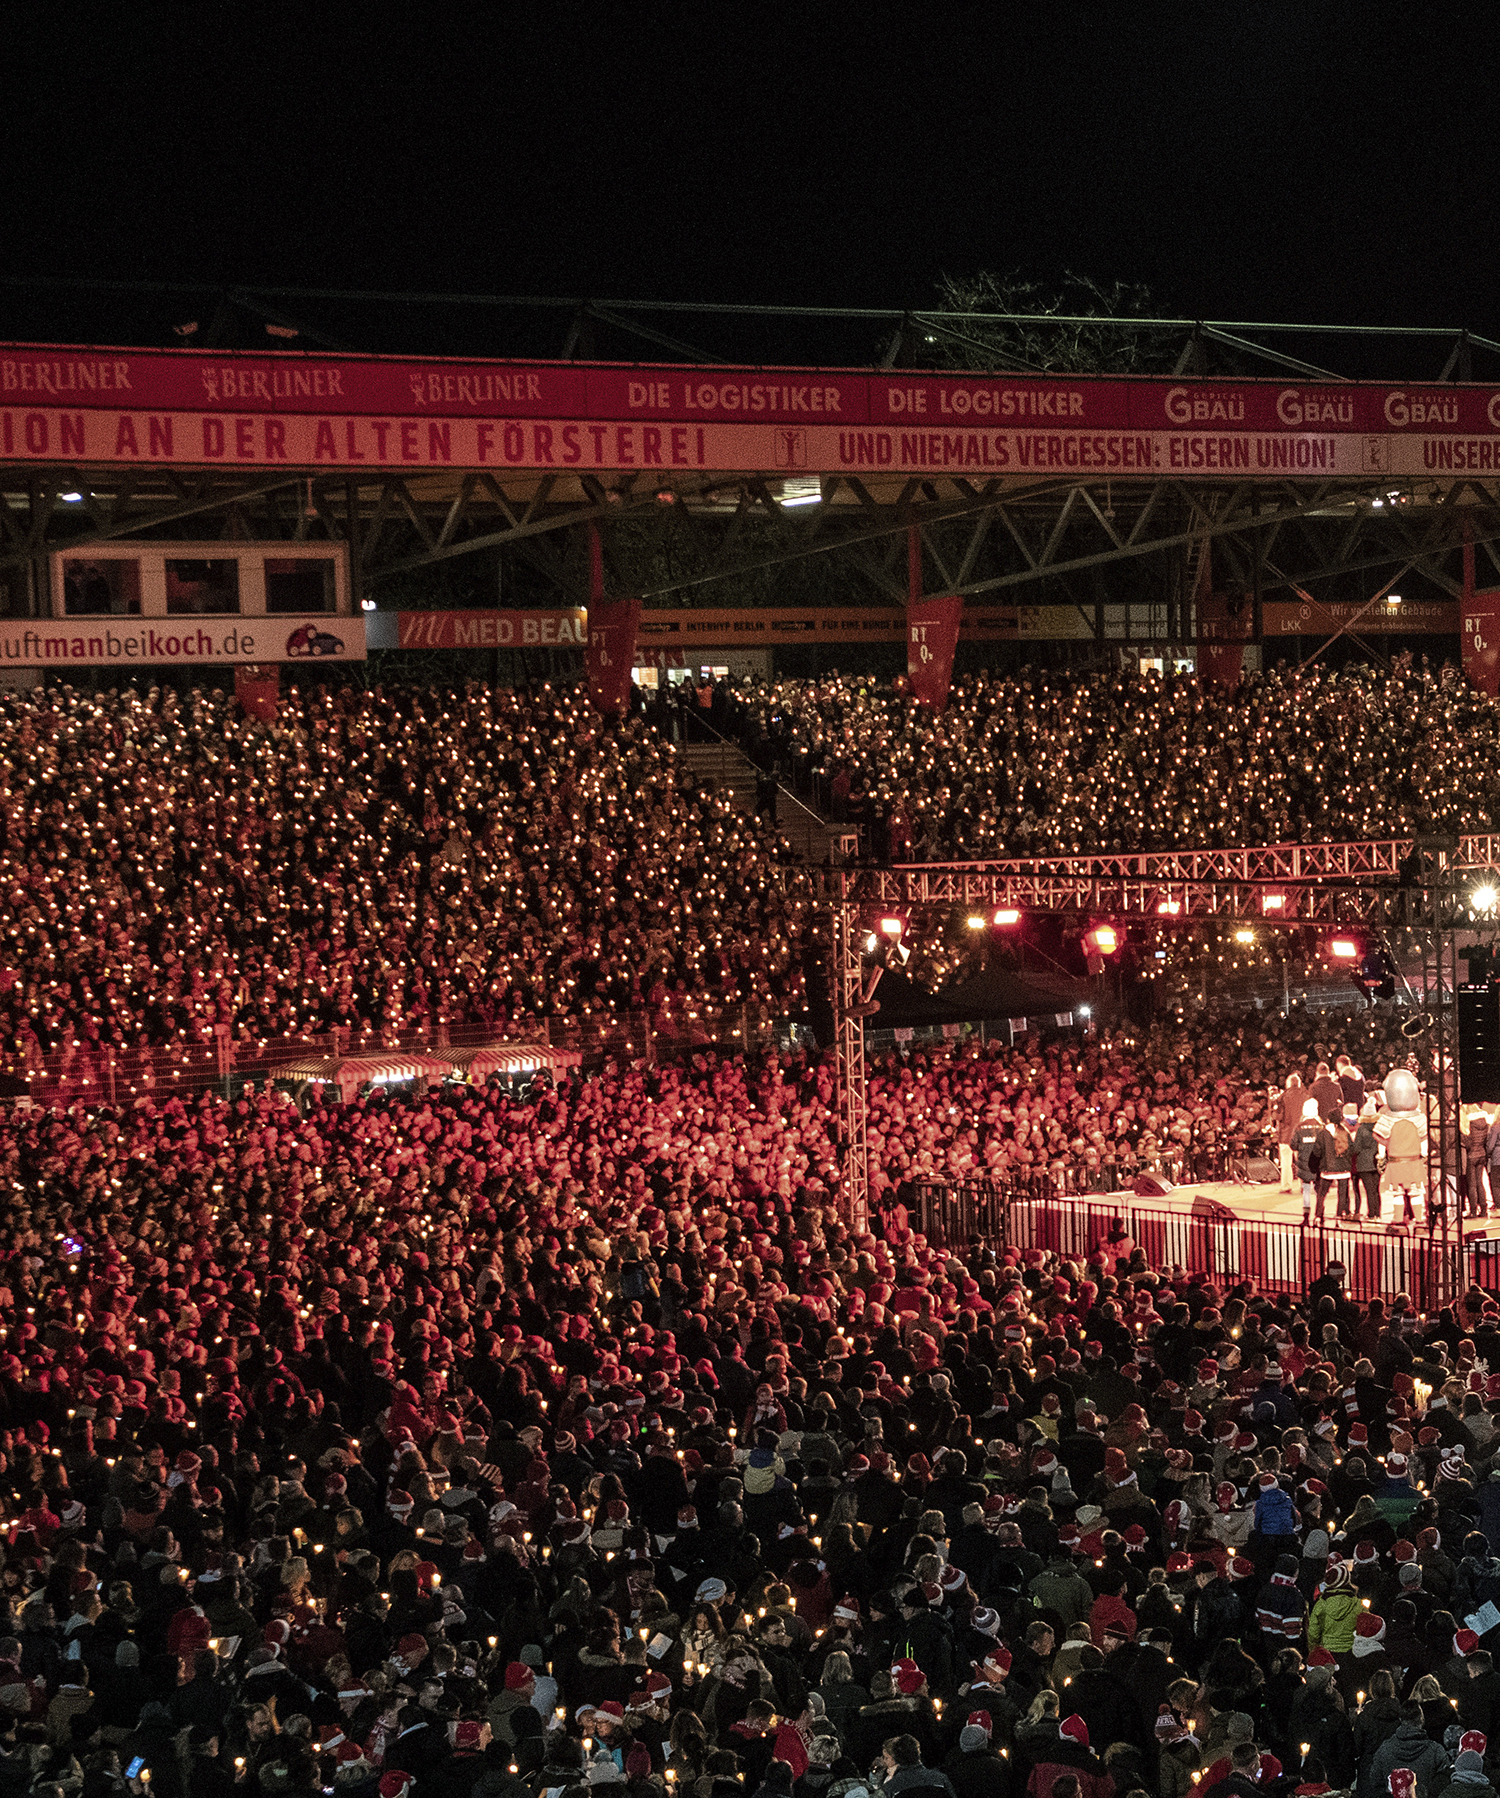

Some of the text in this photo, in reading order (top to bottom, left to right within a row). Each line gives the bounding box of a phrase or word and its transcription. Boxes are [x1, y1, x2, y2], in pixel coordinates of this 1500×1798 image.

[1, 361, 133, 394] BERLINER
[221, 368, 344, 401] BERLINER
[428, 373, 542, 406] BERLINER
[629, 382, 842, 411] DIE LOGISTIKER
[888, 388, 1085, 416] DIE LOGISTIKER
[116, 415, 174, 457] AN
[202, 417, 287, 459] DER
[314, 420, 451, 461] ALTEN
[476, 421, 706, 465] FÖRSTEREI
[839, 432, 1336, 468] UND NIEMALS VERGESSEN: EISERN UNION!
[454, 618, 514, 644] MED
